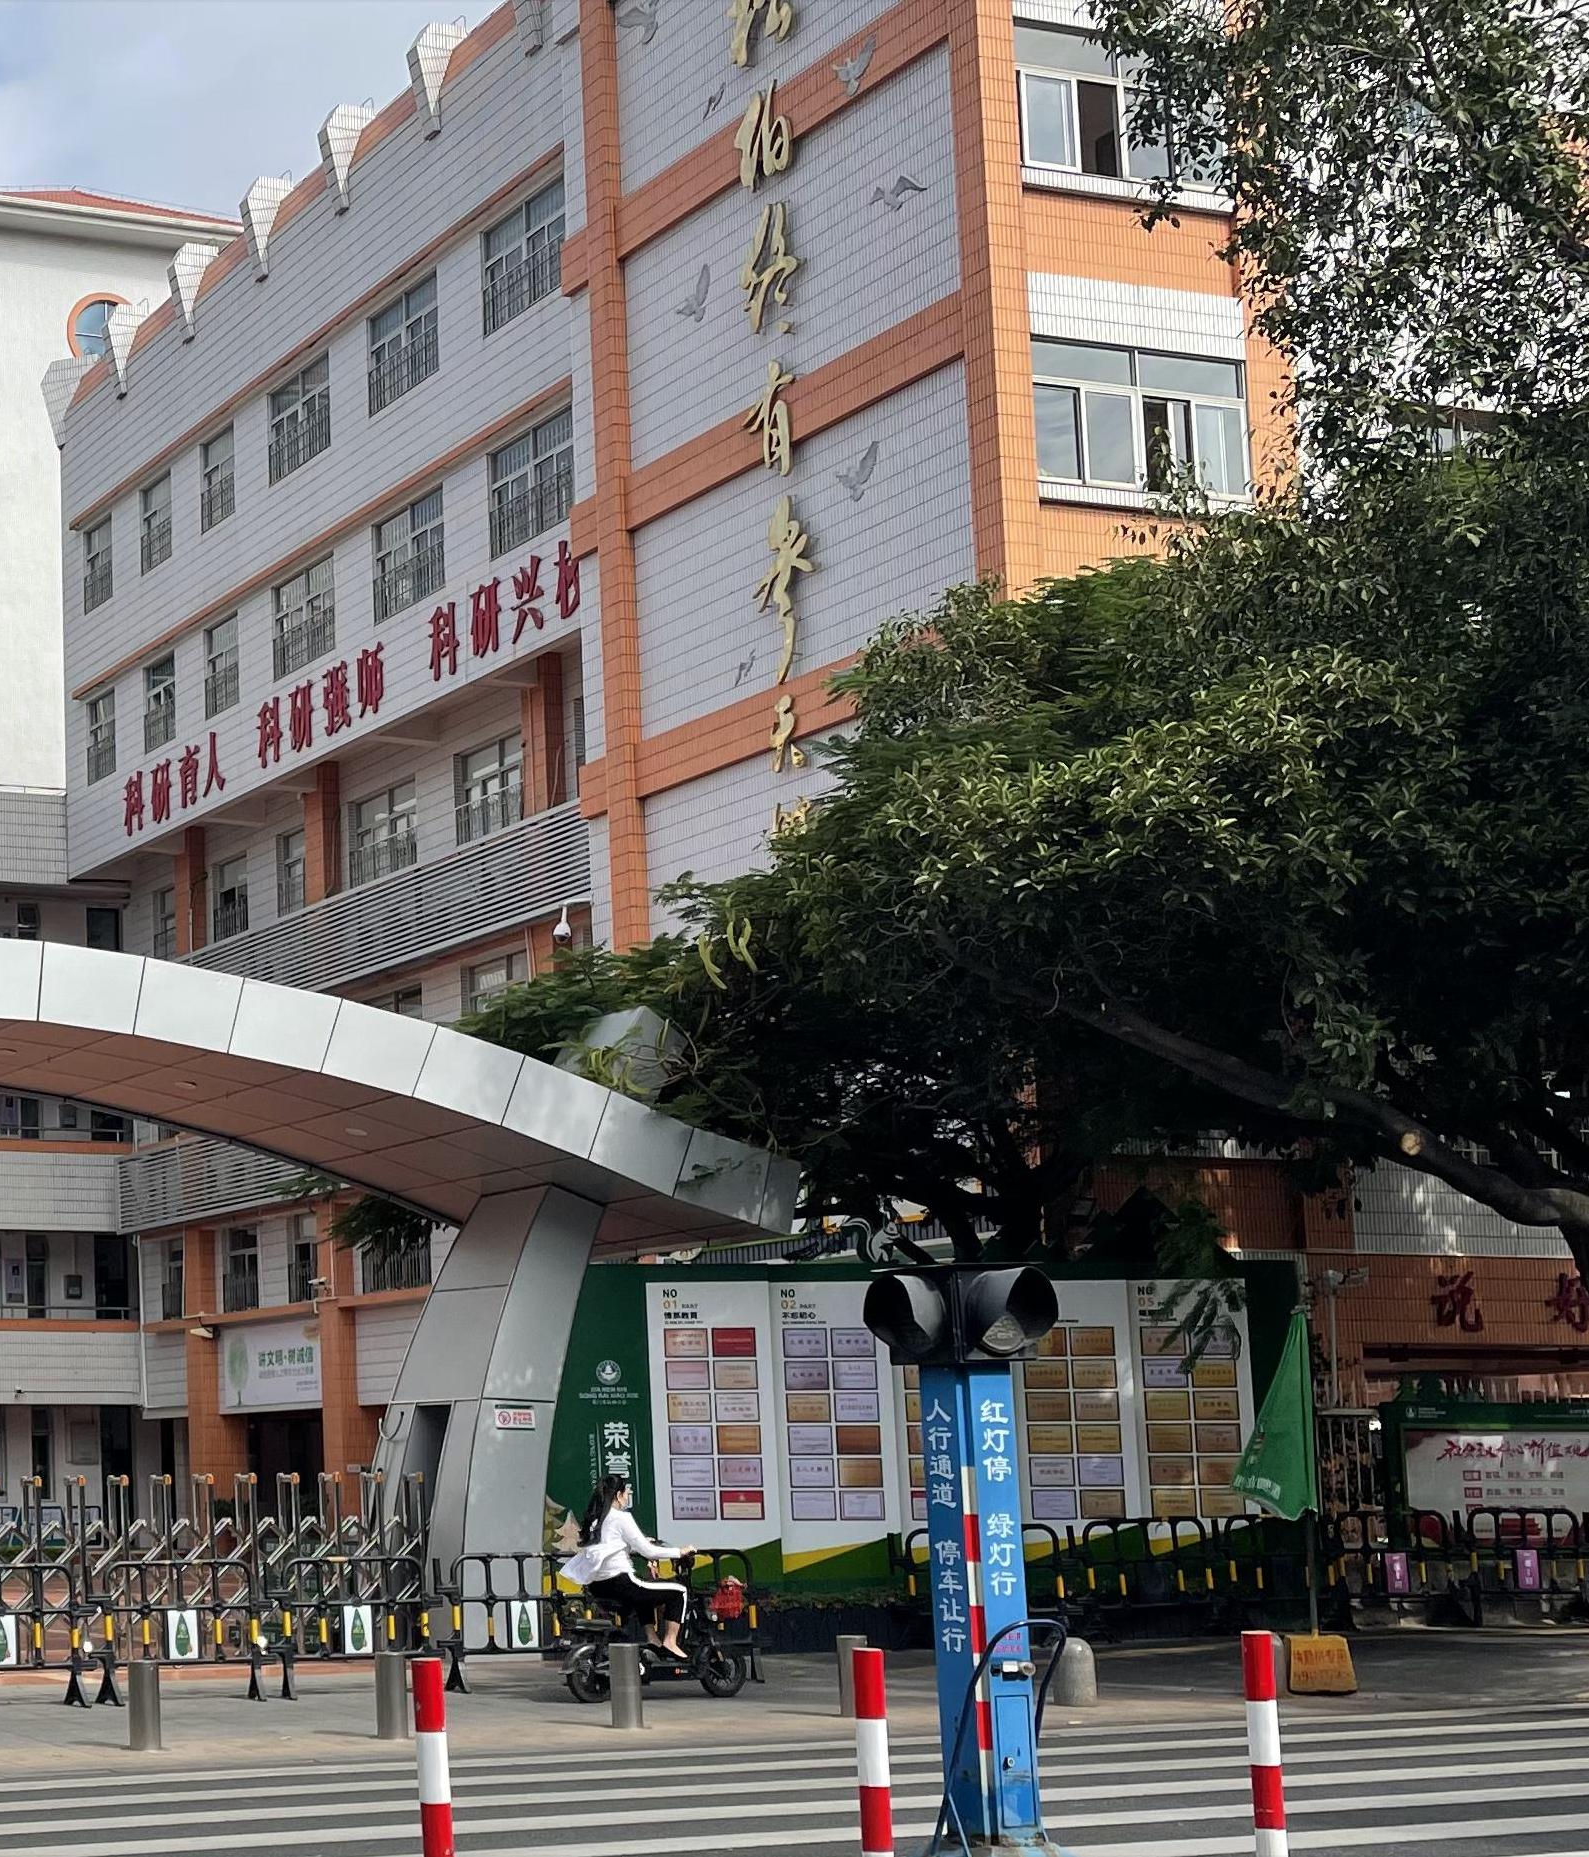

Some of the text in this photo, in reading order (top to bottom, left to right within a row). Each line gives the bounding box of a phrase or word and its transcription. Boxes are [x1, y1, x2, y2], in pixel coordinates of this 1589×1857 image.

[123, 731, 226, 837] 科研育人
[256, 640, 385, 769] 科研强师
[662, 1289, 678, 1298] NO
[662, 1300, 678, 1309] 01
[780, 1289, 796, 1298] NO
[780, 1300, 797, 1309] 02
[980, 1399, 1012, 1483] 红灯停
[926, 1398, 966, 1653] 人行通道 停车让行
[987, 1512, 1018, 1597] 绿灯行
